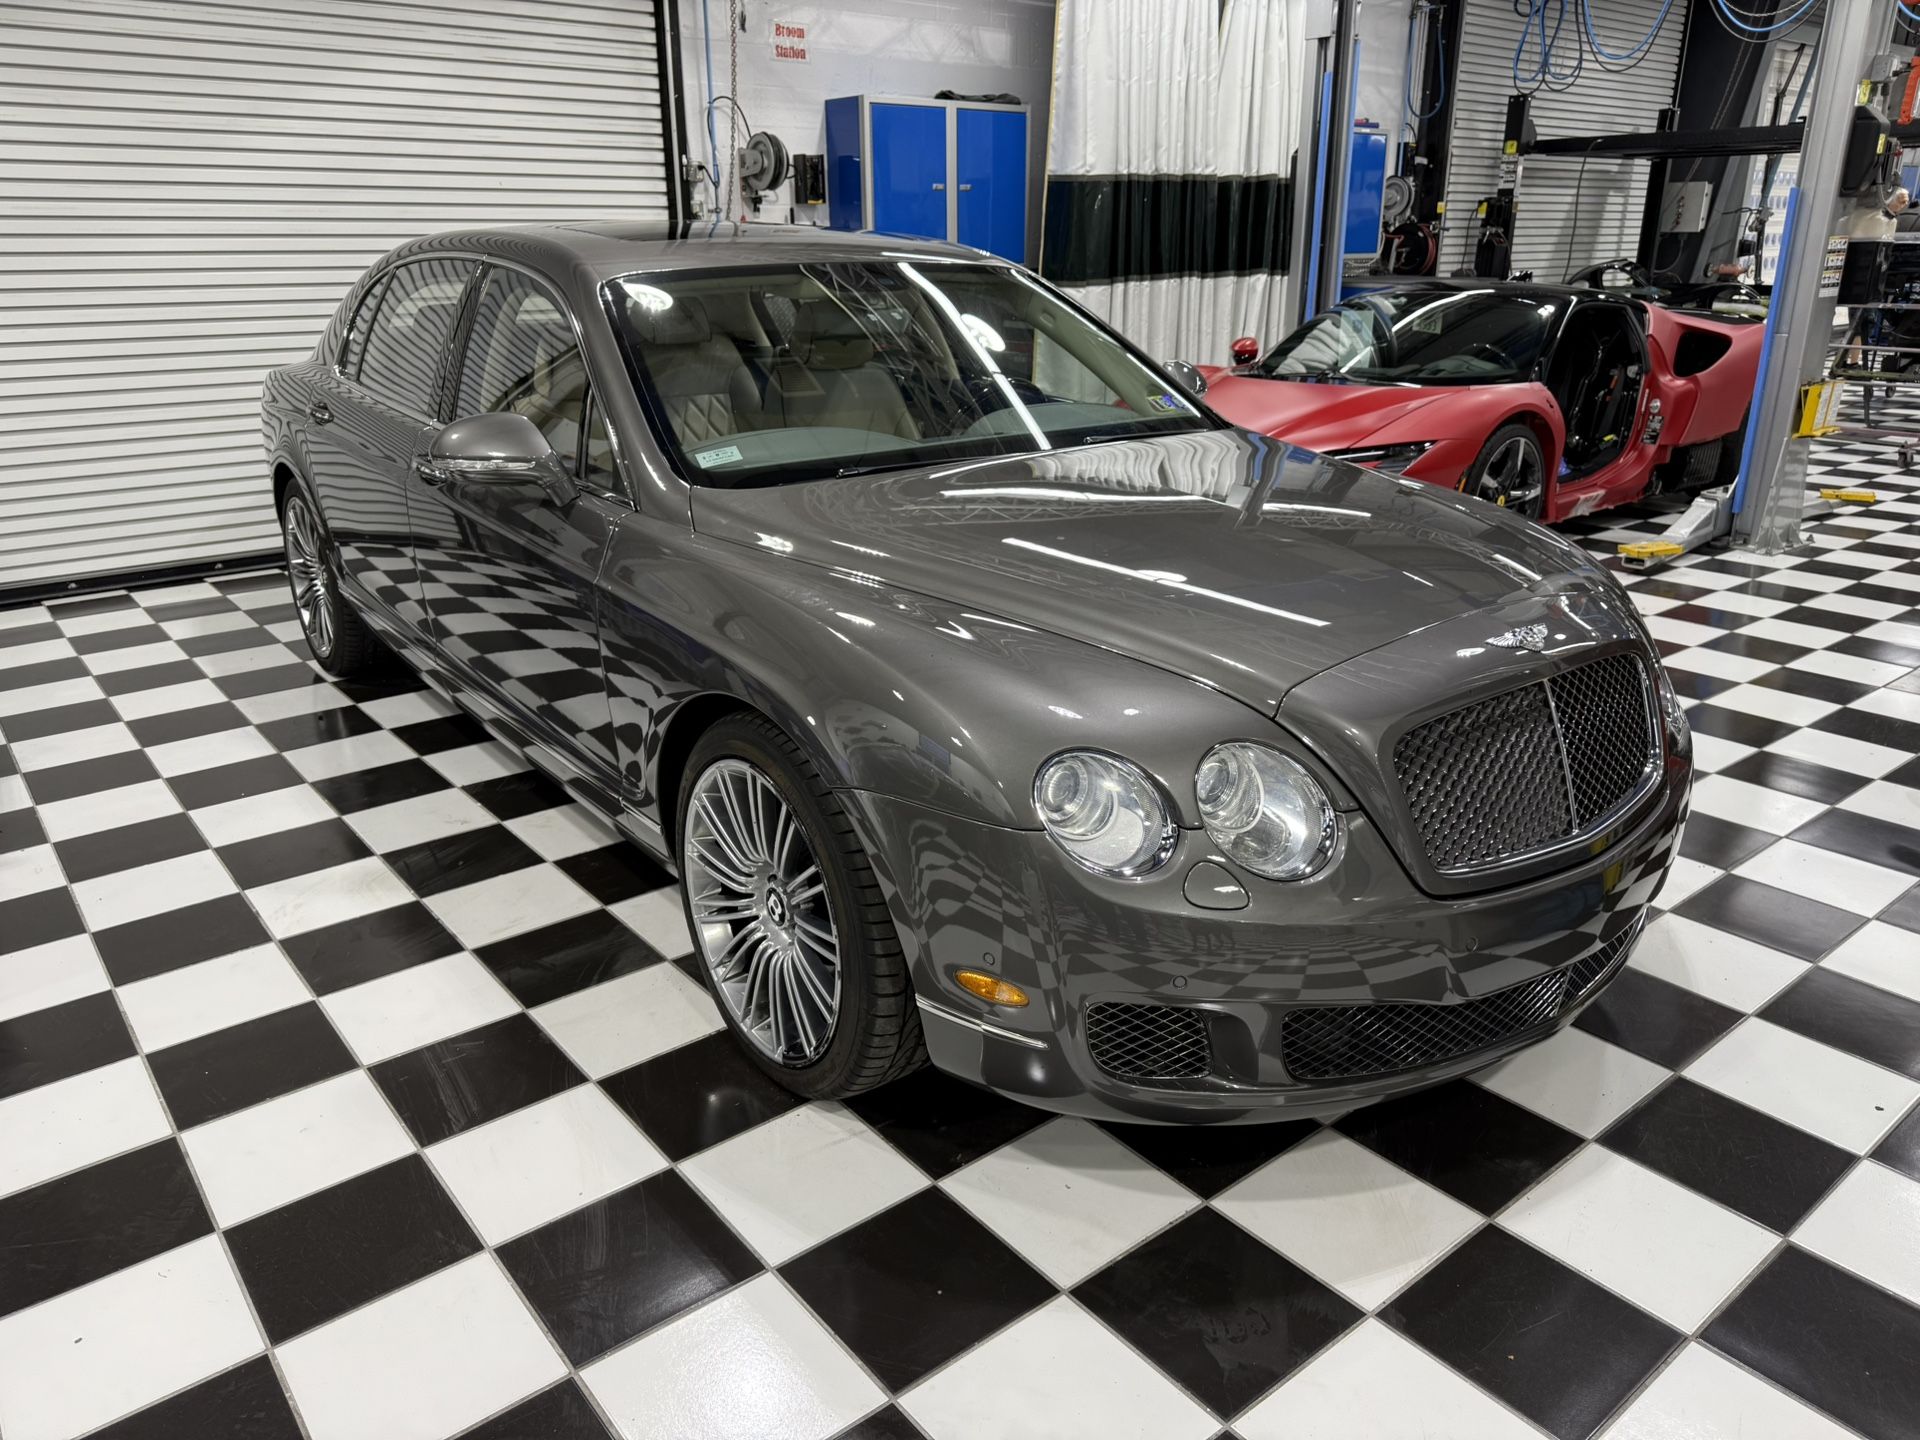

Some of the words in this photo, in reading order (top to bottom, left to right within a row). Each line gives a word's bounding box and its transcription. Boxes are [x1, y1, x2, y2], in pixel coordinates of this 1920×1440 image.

[775, 23, 805, 39] Broom
[775, 44, 806, 59] Station
[768, 894, 782, 921] B
